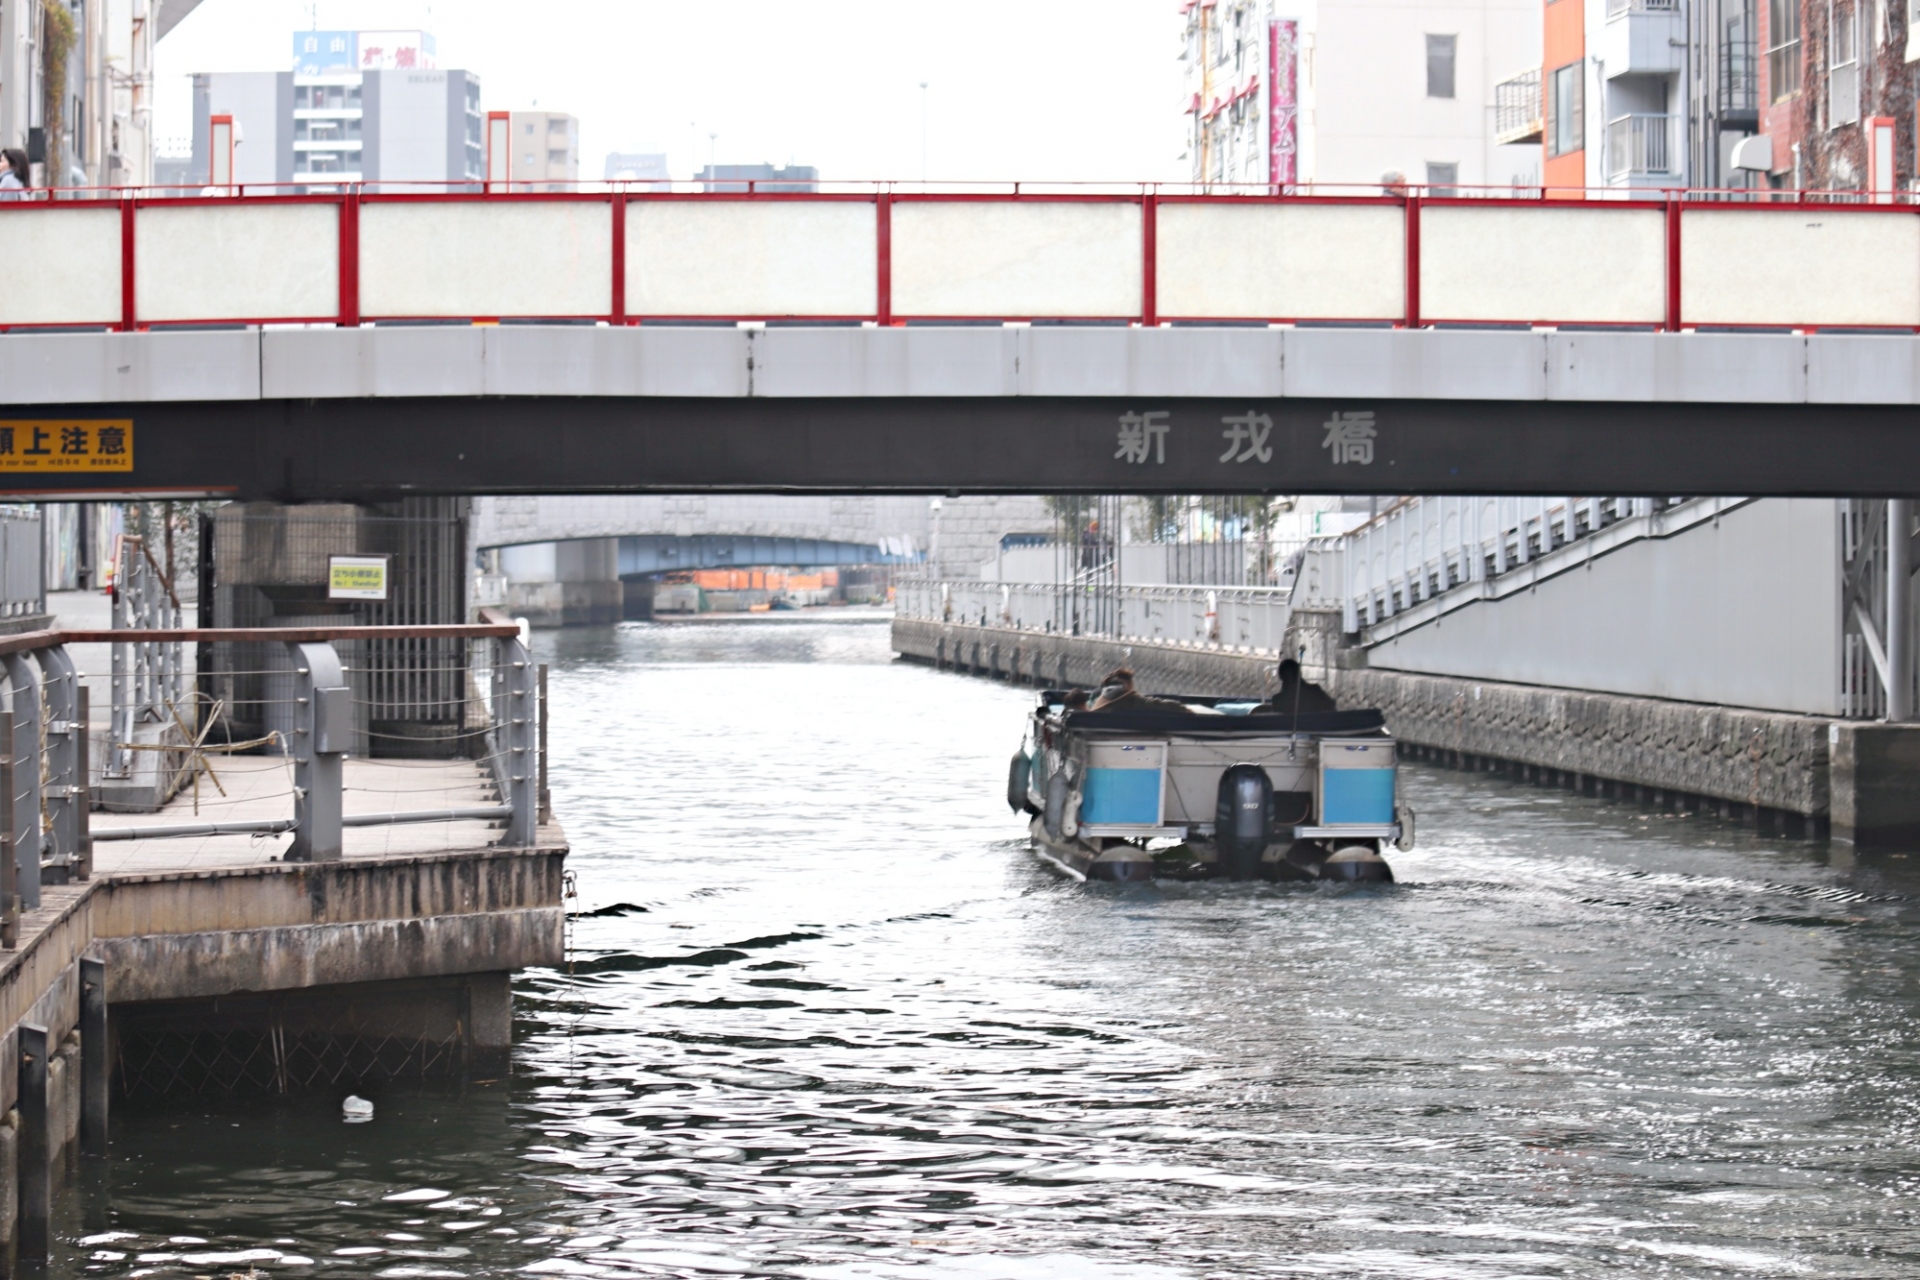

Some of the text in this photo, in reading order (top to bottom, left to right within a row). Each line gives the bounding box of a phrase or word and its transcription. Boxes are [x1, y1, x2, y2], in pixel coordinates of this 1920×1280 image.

[304, 36, 346, 54] 自由
[1114, 410, 1378, 465] 新戎橋
